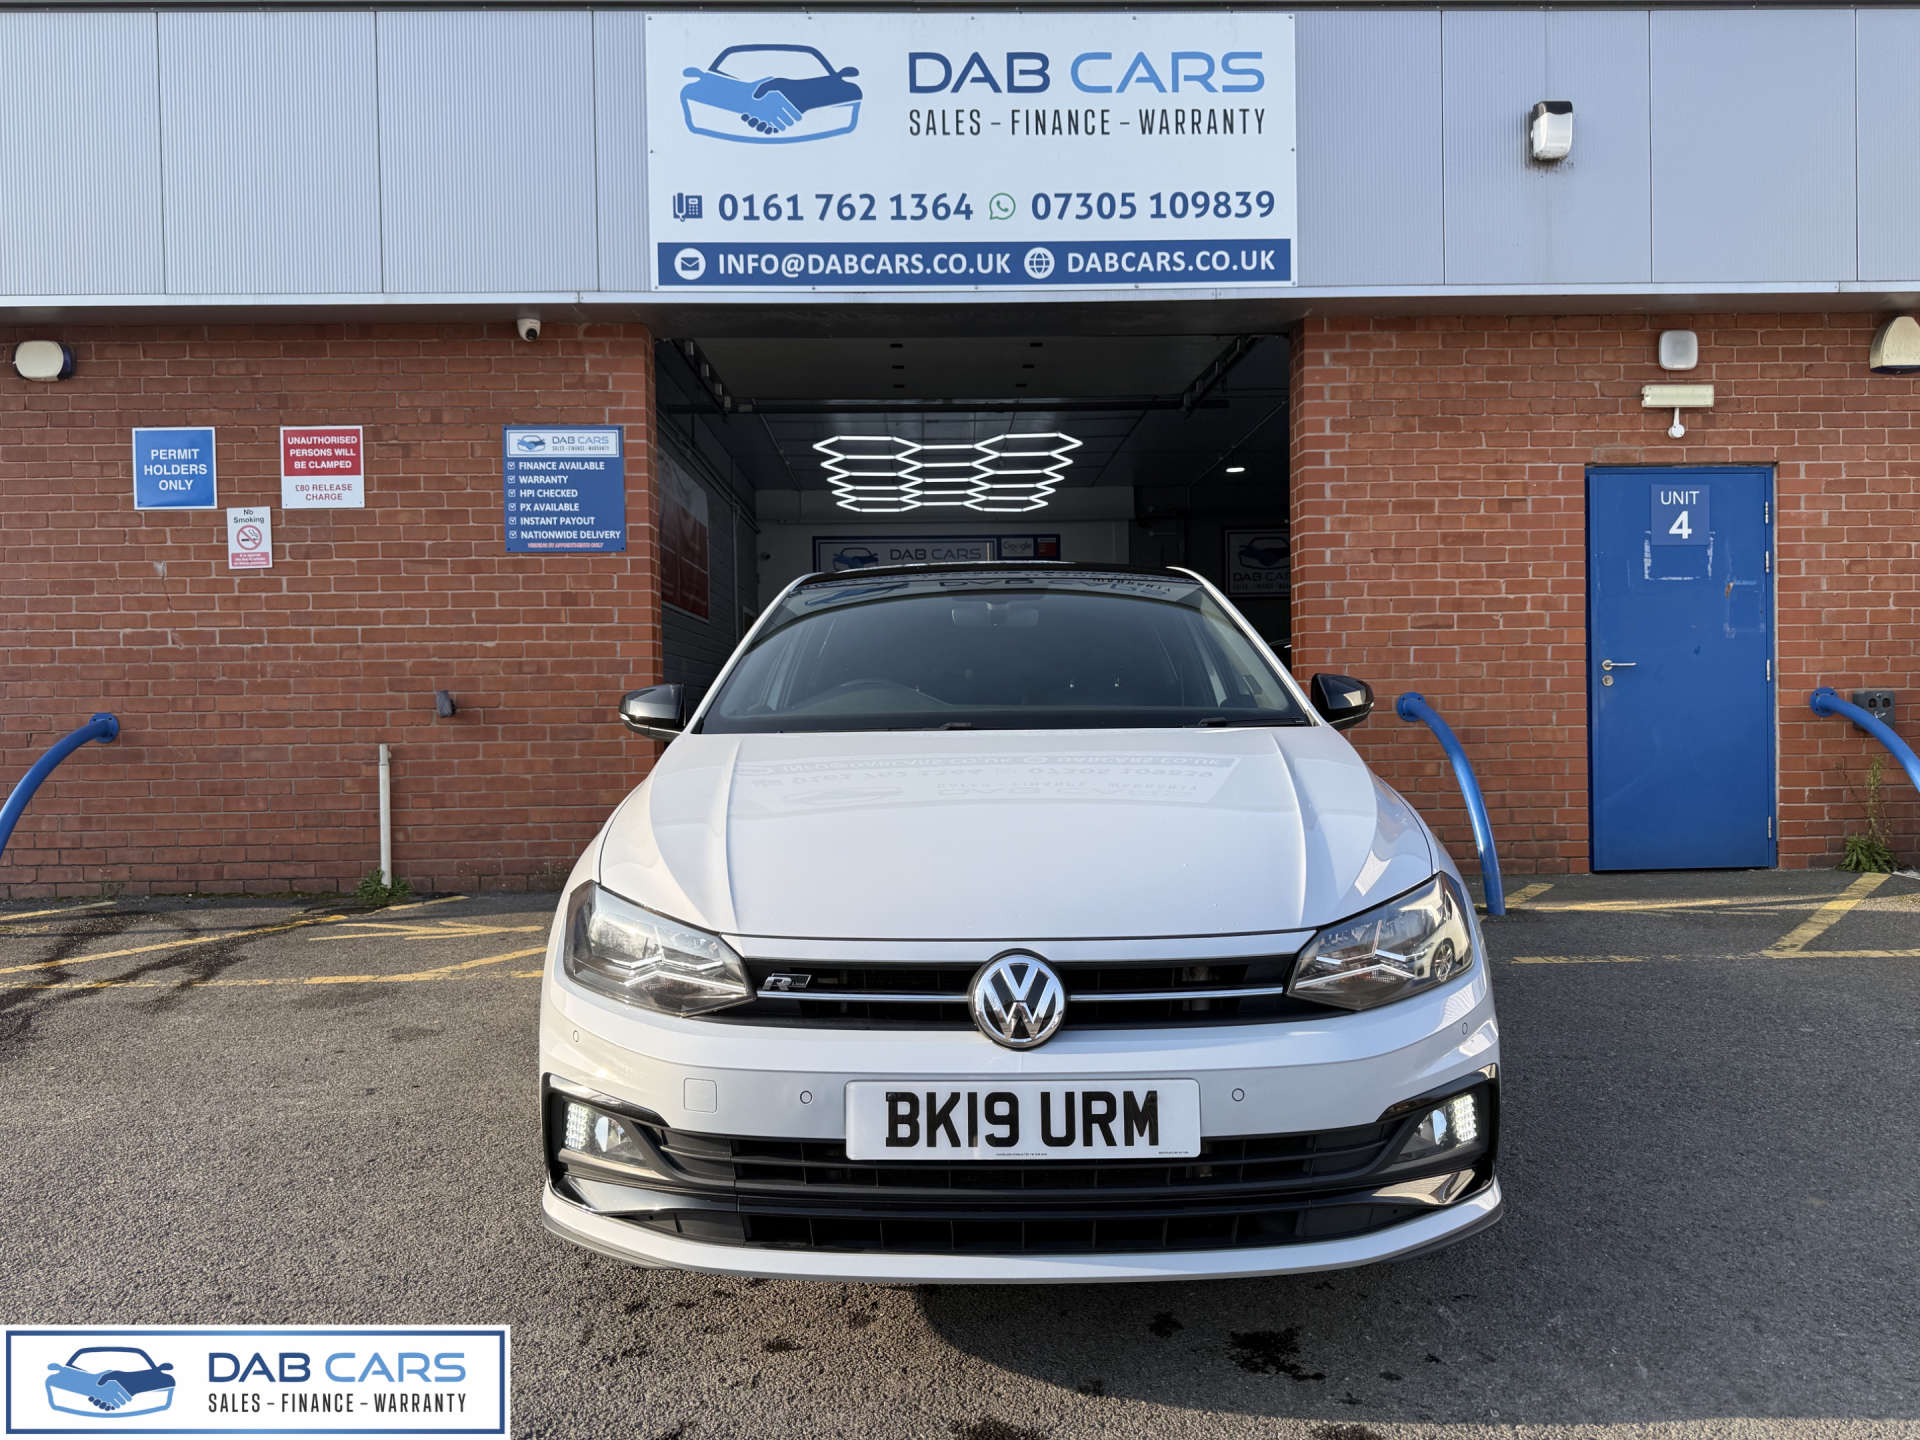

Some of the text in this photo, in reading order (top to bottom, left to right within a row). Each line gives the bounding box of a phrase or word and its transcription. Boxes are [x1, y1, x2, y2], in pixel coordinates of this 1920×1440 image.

[908, 51, 1265, 93] DAB CARS
[909, 108, 982, 136] SALES
[1011, 108, 1111, 136] FINANCE
[1138, 107, 1265, 135] WARRANTY
[718, 192, 973, 221] 0161 762 1364
[1031, 190, 1275, 220] 07305 109839
[718, 252, 1011, 278] INFO@DABCARS.CO.UK
[1066, 249, 1276, 273] DABCARS.CO.UK
[287, 435, 358, 445] UNAUTHORISED
[552, 436, 575, 445] DAB
[151, 448, 200, 460] PERMIT
[289, 447, 356, 457] PERSONS WILL
[143, 463, 208, 476] HOLDERS
[294, 460, 352, 469] BE CLAMPED
[519, 461, 605, 470] FINANCE AVAILABLE
[158, 479, 194, 491] ONLY
[519, 475, 568, 484] WARRANTY
[295, 483, 353, 492] £80 RELEASE
[305, 493, 343, 501] CHARGE
[520, 489, 578, 498] HPI CHECKED
[1660, 490, 1700, 505] UNIT
[520, 502, 580, 512] PX AVAILABLE
[233, 516, 265, 524] Smoking
[520, 516, 596, 526] INSTANT PAYOUT
[1668, 510, 1693, 539] 4
[520, 530, 621, 540] NATIONWIDE DELIVERY
[890, 548, 982, 561] DAB CARS
[885, 1090, 1159, 1148] BK19 URM
